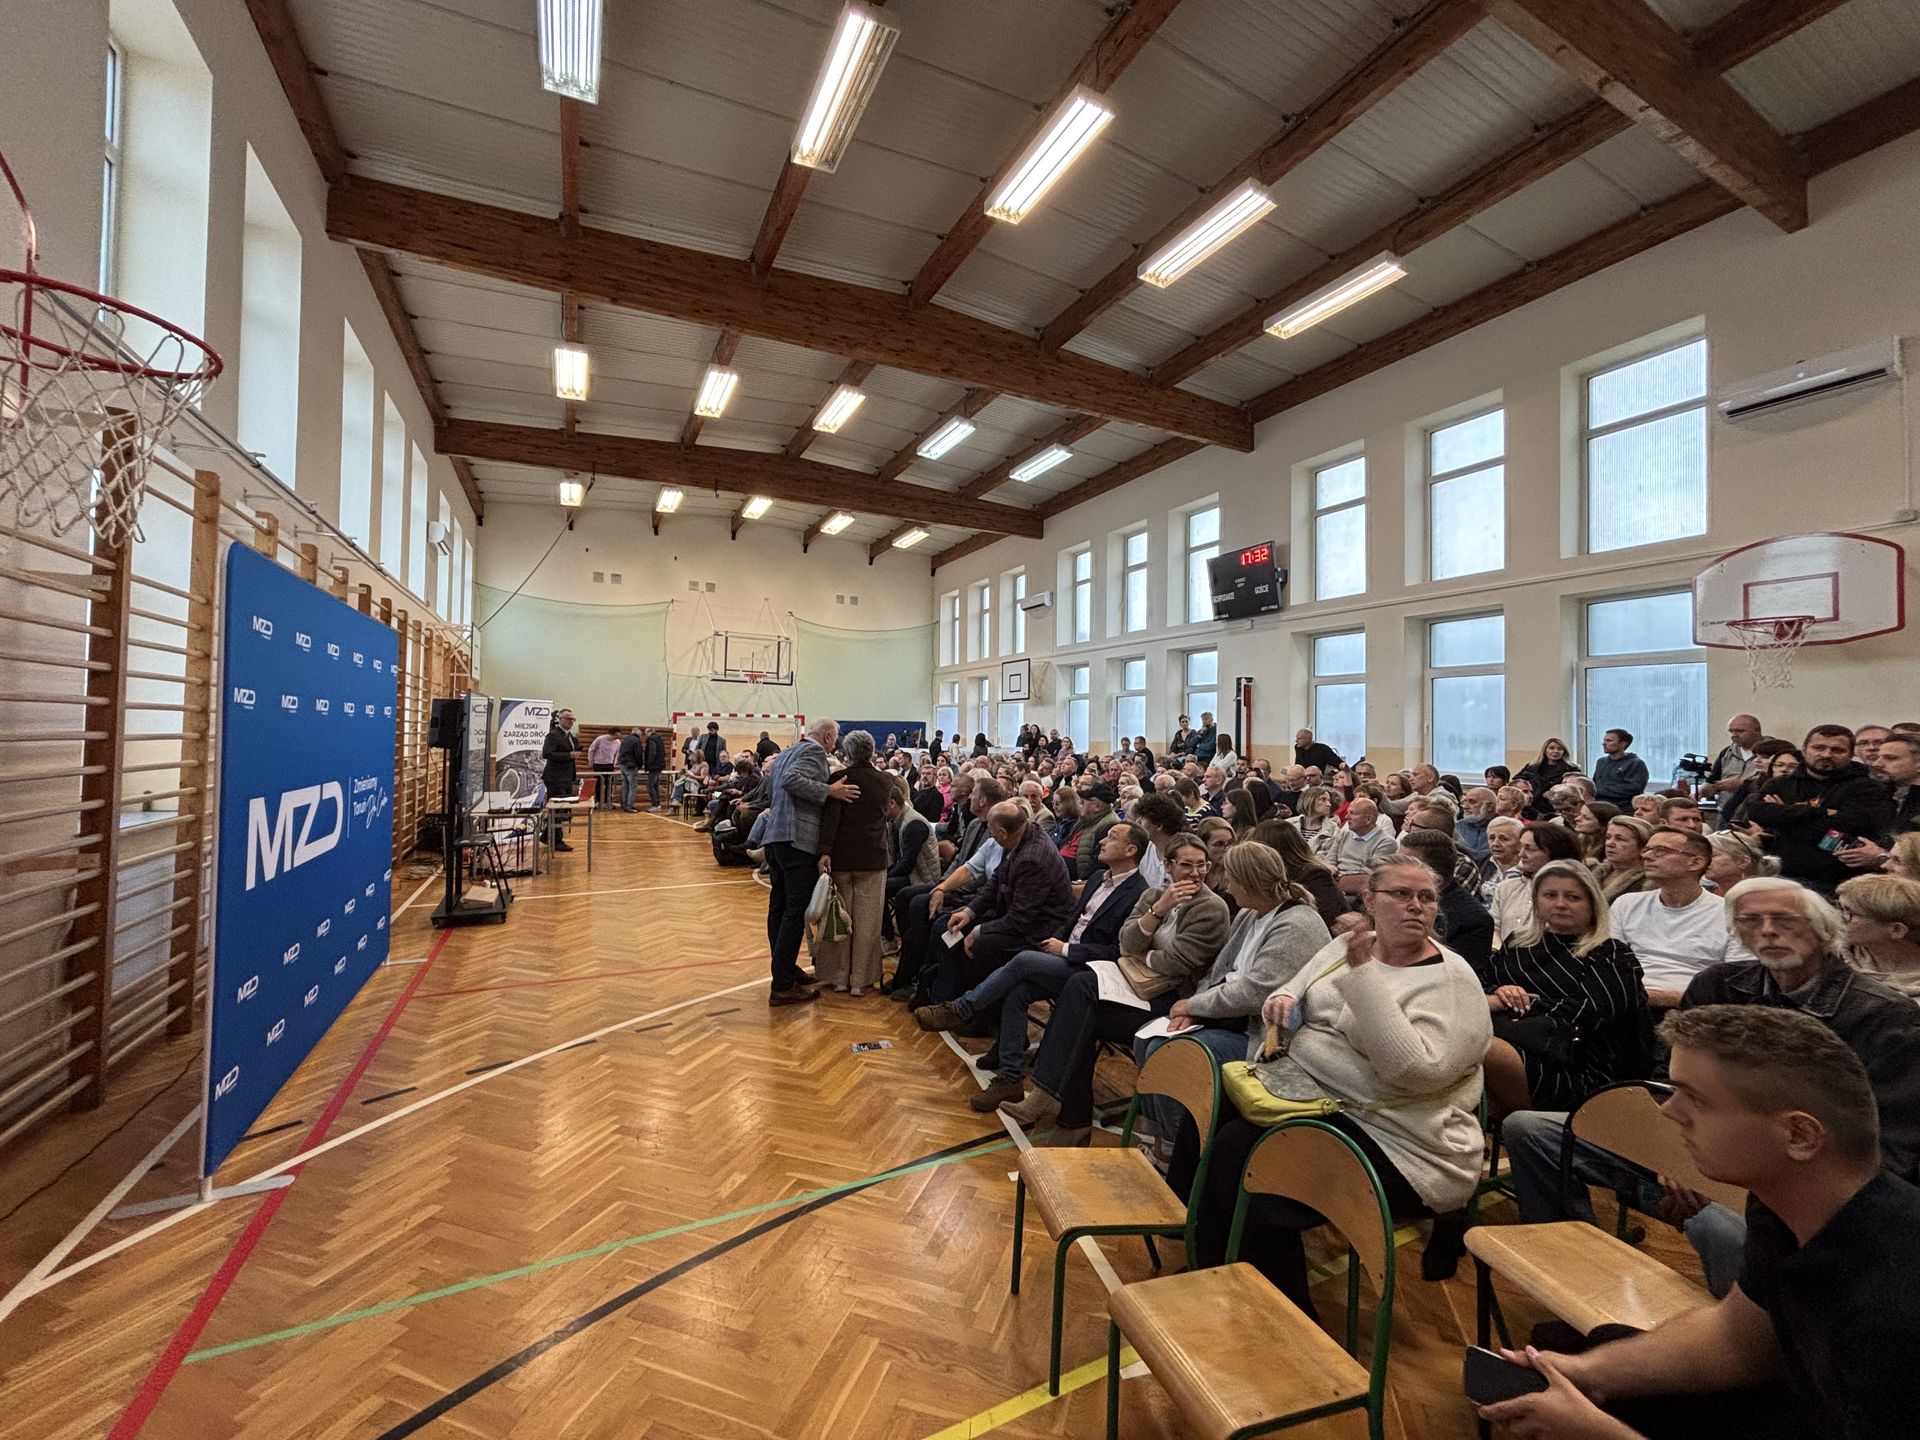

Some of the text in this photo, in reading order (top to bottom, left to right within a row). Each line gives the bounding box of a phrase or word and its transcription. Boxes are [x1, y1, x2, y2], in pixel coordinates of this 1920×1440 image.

[1241, 548, 1268, 566] 17:32
[252, 615, 273, 635] MZD
[296, 632, 311, 647] MZD
[327, 643, 339, 657] MZD
[233, 687, 256, 704] MZD
[281, 694, 298, 709] MZD
[315, 698, 329, 711] MZD
[525, 706, 550, 717] MZD
[503, 731, 529, 739] ZARZĄD
[246, 781, 344, 892] MZD
[345, 898, 356, 914] MZD
[317, 918, 331, 937] MZD
[284, 943, 300, 965] MZD
[334, 956, 346, 975] MZD
[237, 975, 259, 1004] MZD
[304, 985, 319, 1008] MZD
[267, 1018, 285, 1047] MZD
[215, 1065, 239, 1101] MZD
